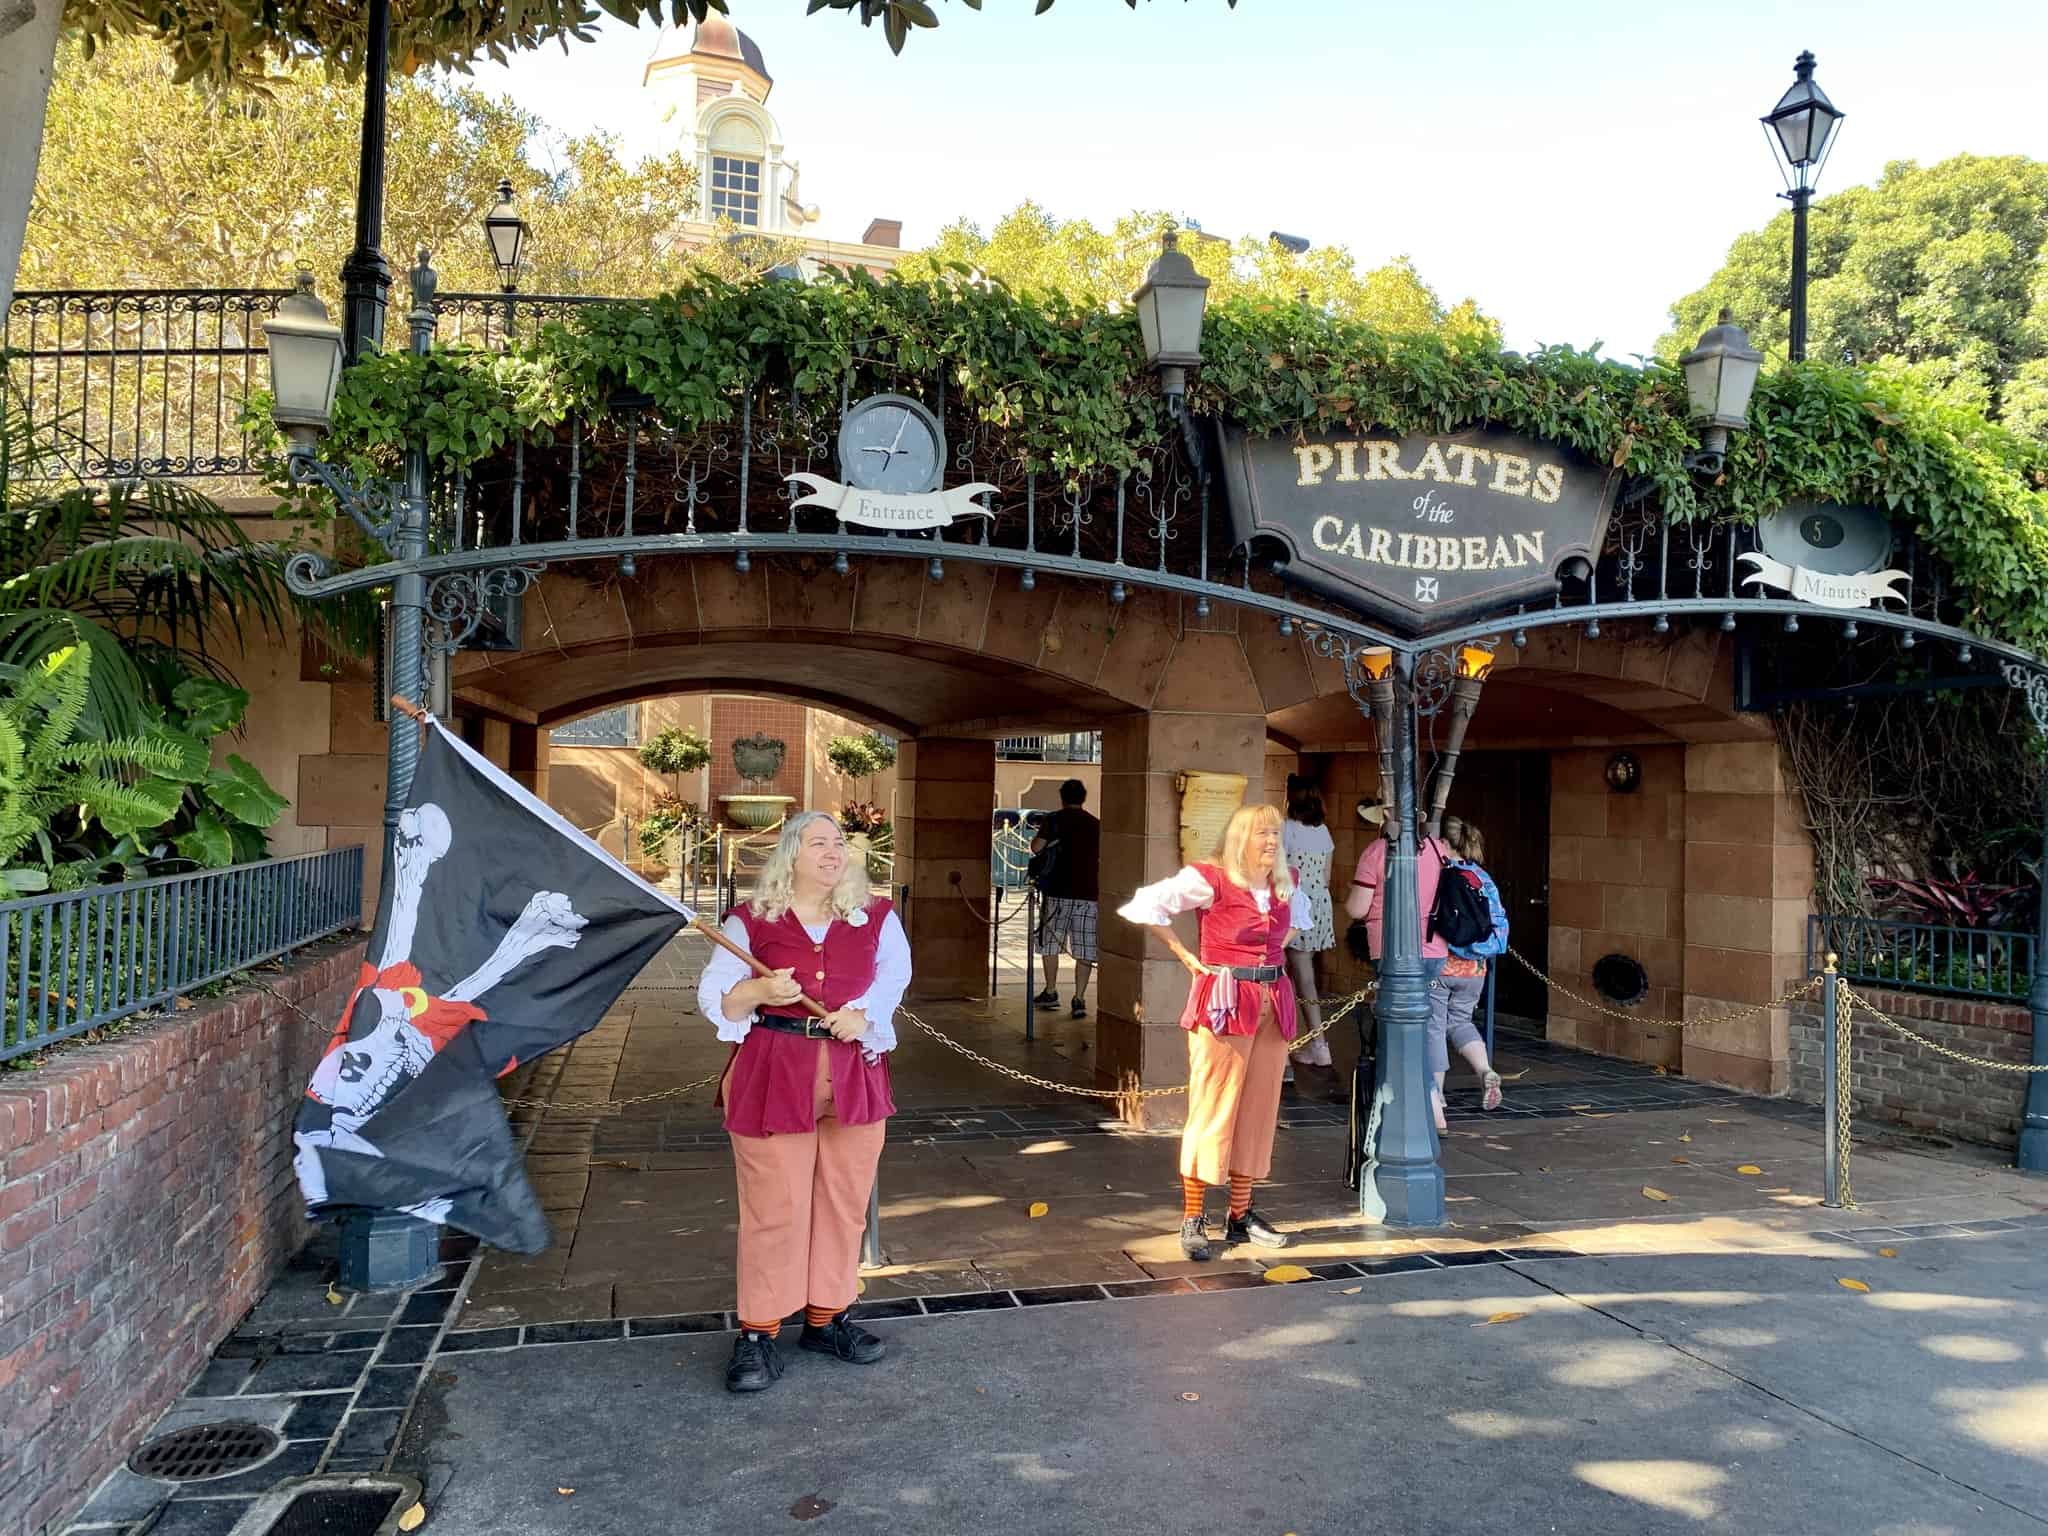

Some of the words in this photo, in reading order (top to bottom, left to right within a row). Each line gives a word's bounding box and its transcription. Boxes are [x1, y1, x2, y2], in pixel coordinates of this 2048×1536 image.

[1293, 440, 1564, 503] PIRATES
[857, 498, 935, 521] Entrance
[1413, 489, 1437, 519] of
[1430, 502, 1456, 525] the
[1312, 515, 1546, 572] CARIBBEAN
[1812, 521, 1823, 542] 5
[1804, 575, 1868, 601] Minutes
